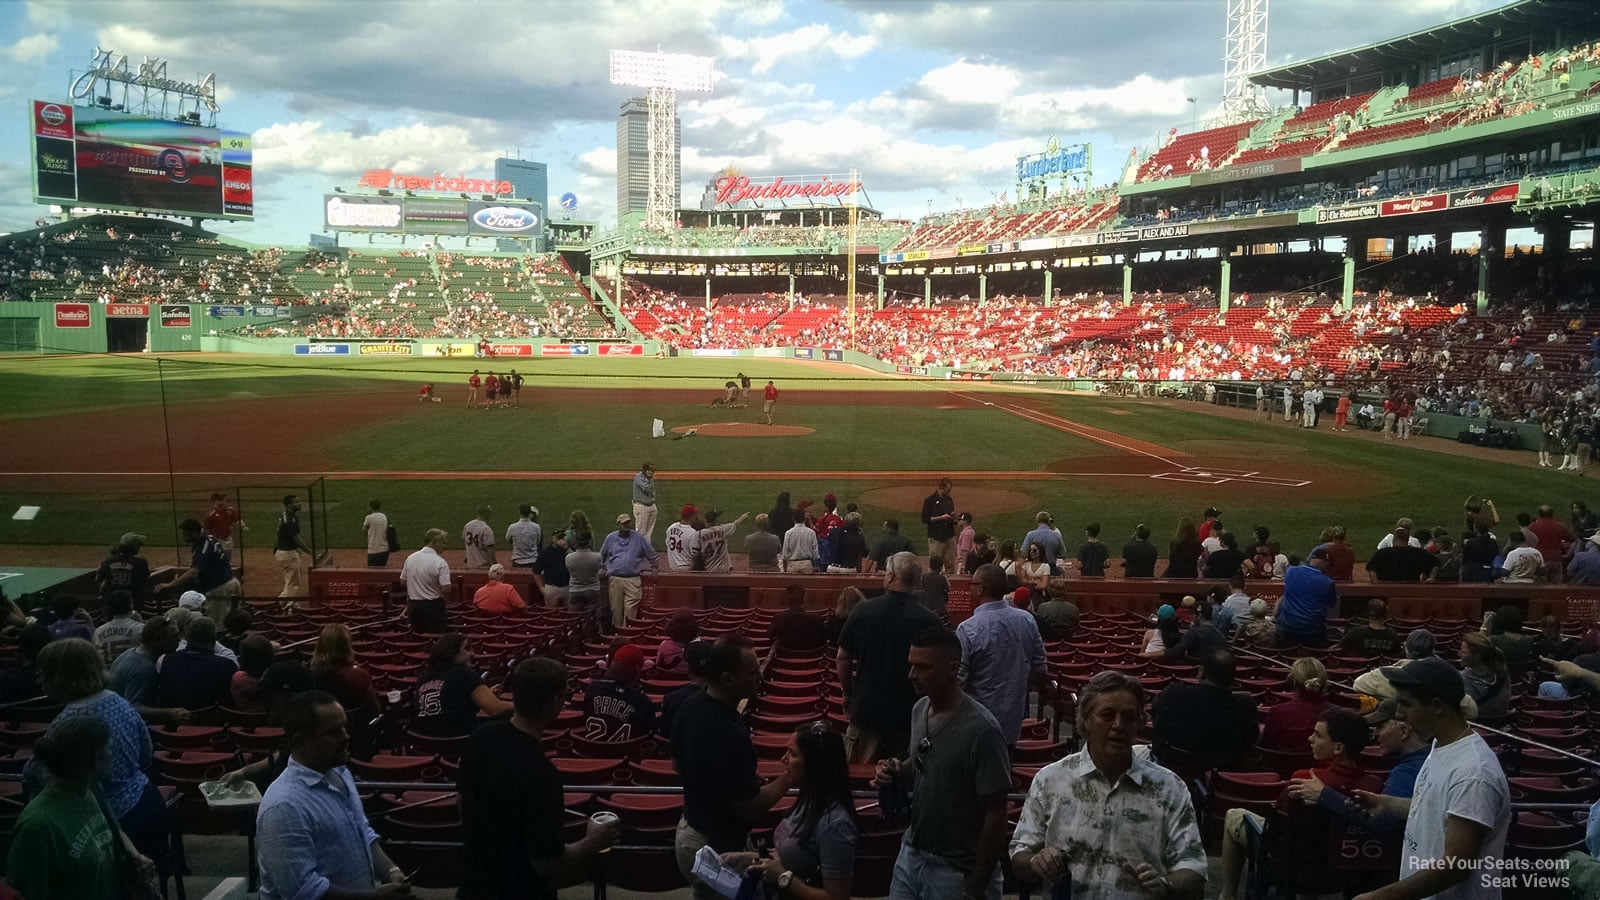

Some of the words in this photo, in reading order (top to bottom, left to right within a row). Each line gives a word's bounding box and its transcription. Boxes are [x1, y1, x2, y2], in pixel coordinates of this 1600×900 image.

[41, 110, 66, 120] NISSAN
[1553, 107, 1575, 120] STATE
[1017, 144, 1086, 179] Cumberland
[128, 166, 159, 175] PRESENTED
[1241, 164, 1275, 177] STARTERS
[225, 180, 251, 191] ENEOS
[394, 173, 432, 190] new
[434, 172, 512, 195] balance
[715, 175, 862, 204] Budweiser
[1453, 195, 1486, 207] Safelite
[486, 206, 524, 227] Ford
[1329, 211, 1339, 220] The
[1340, 208, 1359, 218] Boston
[1359, 206, 1376, 216] Globe
[1143, 228, 1159, 239] ALEX
[1160, 226, 1175, 237] AND
[1175, 225, 1187, 236] ANI
[112, 305, 143, 315] aetna
[308, 344, 337, 354] jetBlue
[360, 345, 394, 354] GRANITE
[394, 345, 410, 354] CITY
[494, 344, 522, 355] xfinity
[466, 531, 479, 547] 34
[670, 537, 684, 553] 34
[418, 690, 442, 717] 15
[593, 696, 636, 722] PRICE
[585, 715, 631, 742] 24
[1340, 839, 1383, 858] 56
